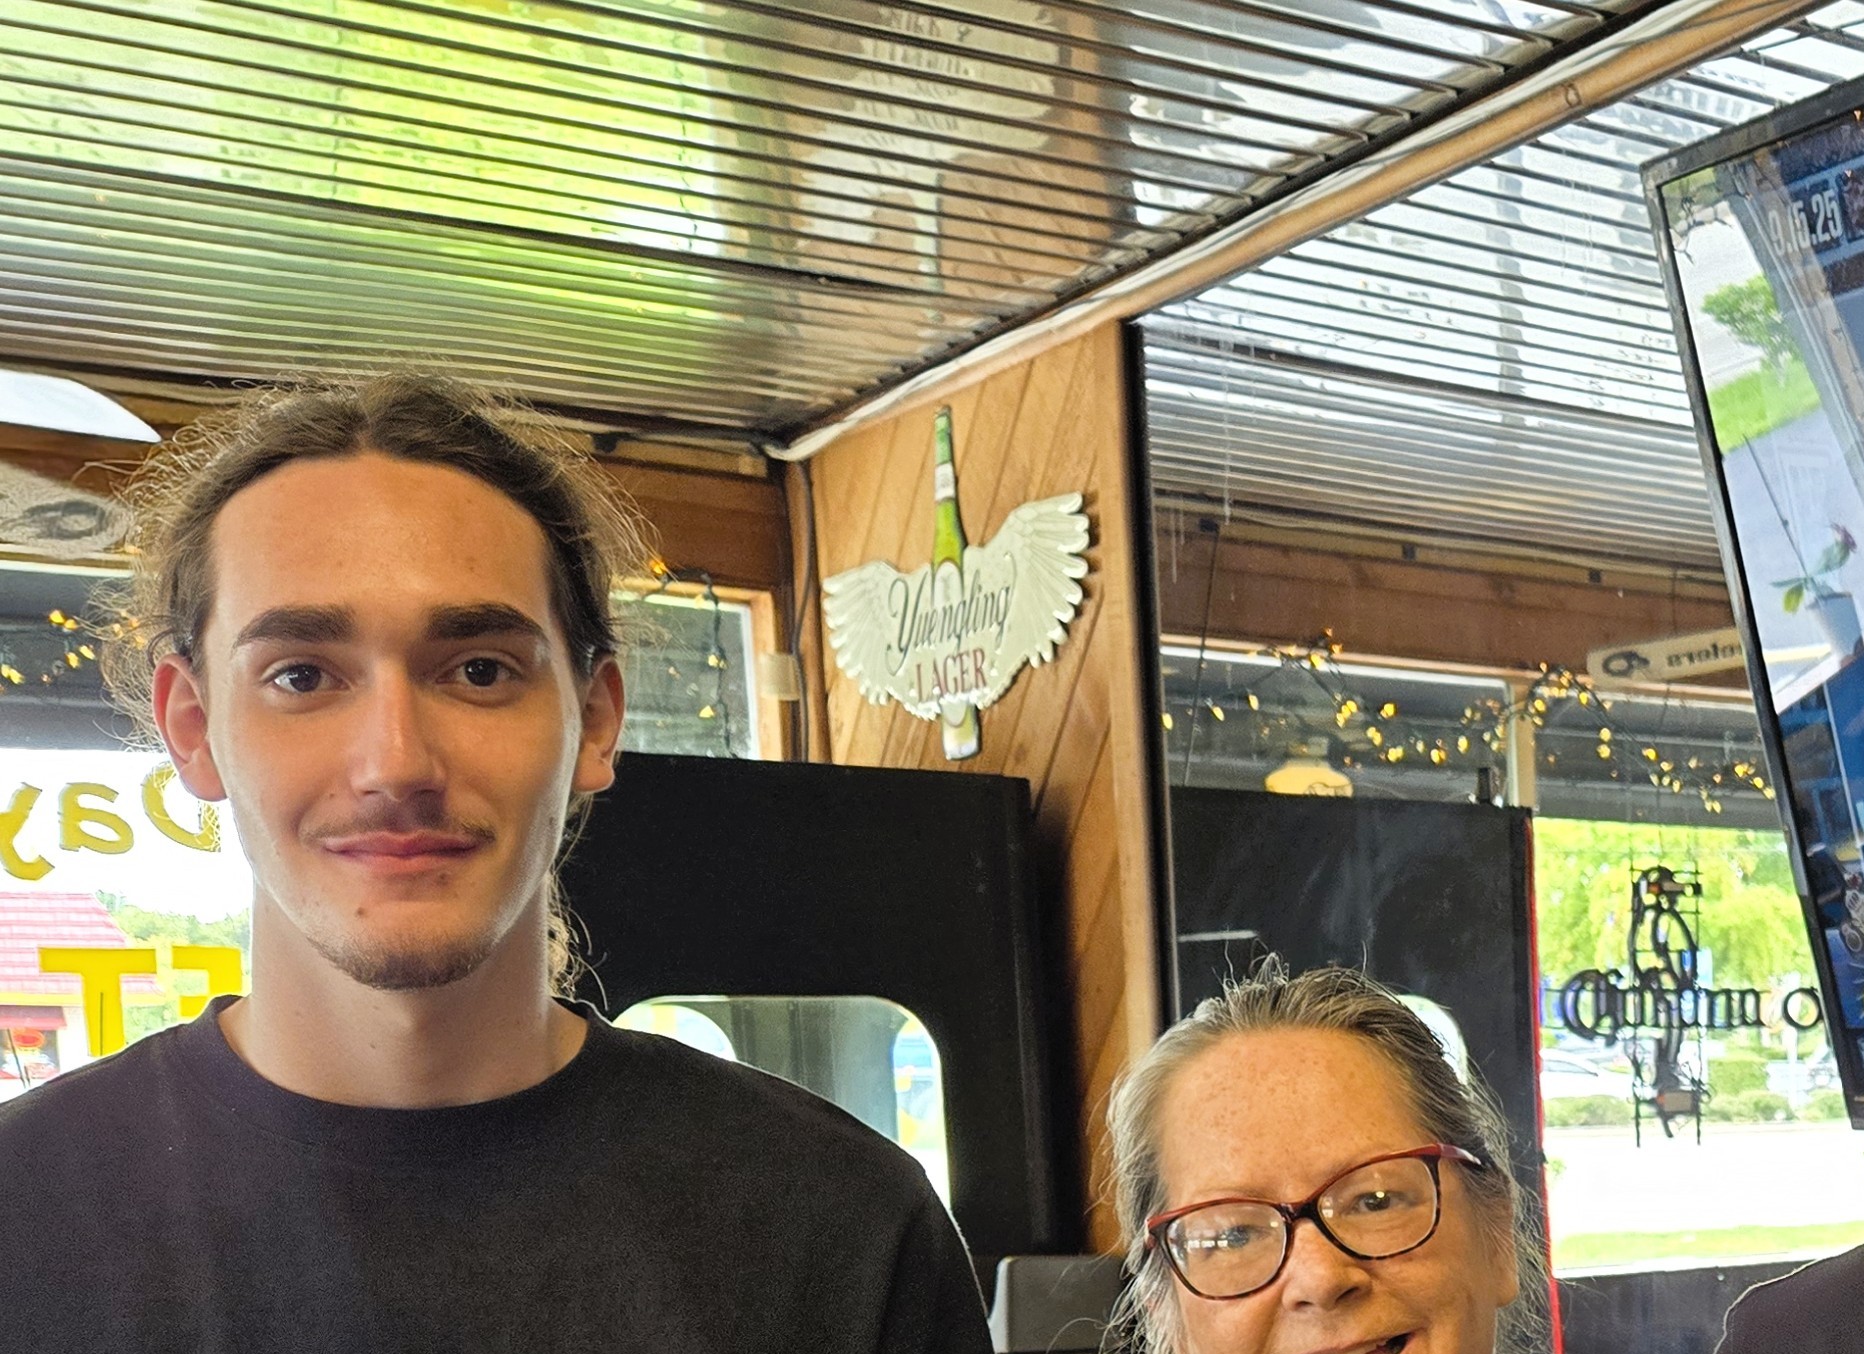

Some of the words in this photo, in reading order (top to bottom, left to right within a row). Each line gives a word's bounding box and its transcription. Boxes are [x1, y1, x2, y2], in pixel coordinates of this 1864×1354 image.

[1768, 189, 1843, 256] 9.15.25
[885, 552, 1017, 677] Yuengling
[915, 647, 988, 702] LAGER
